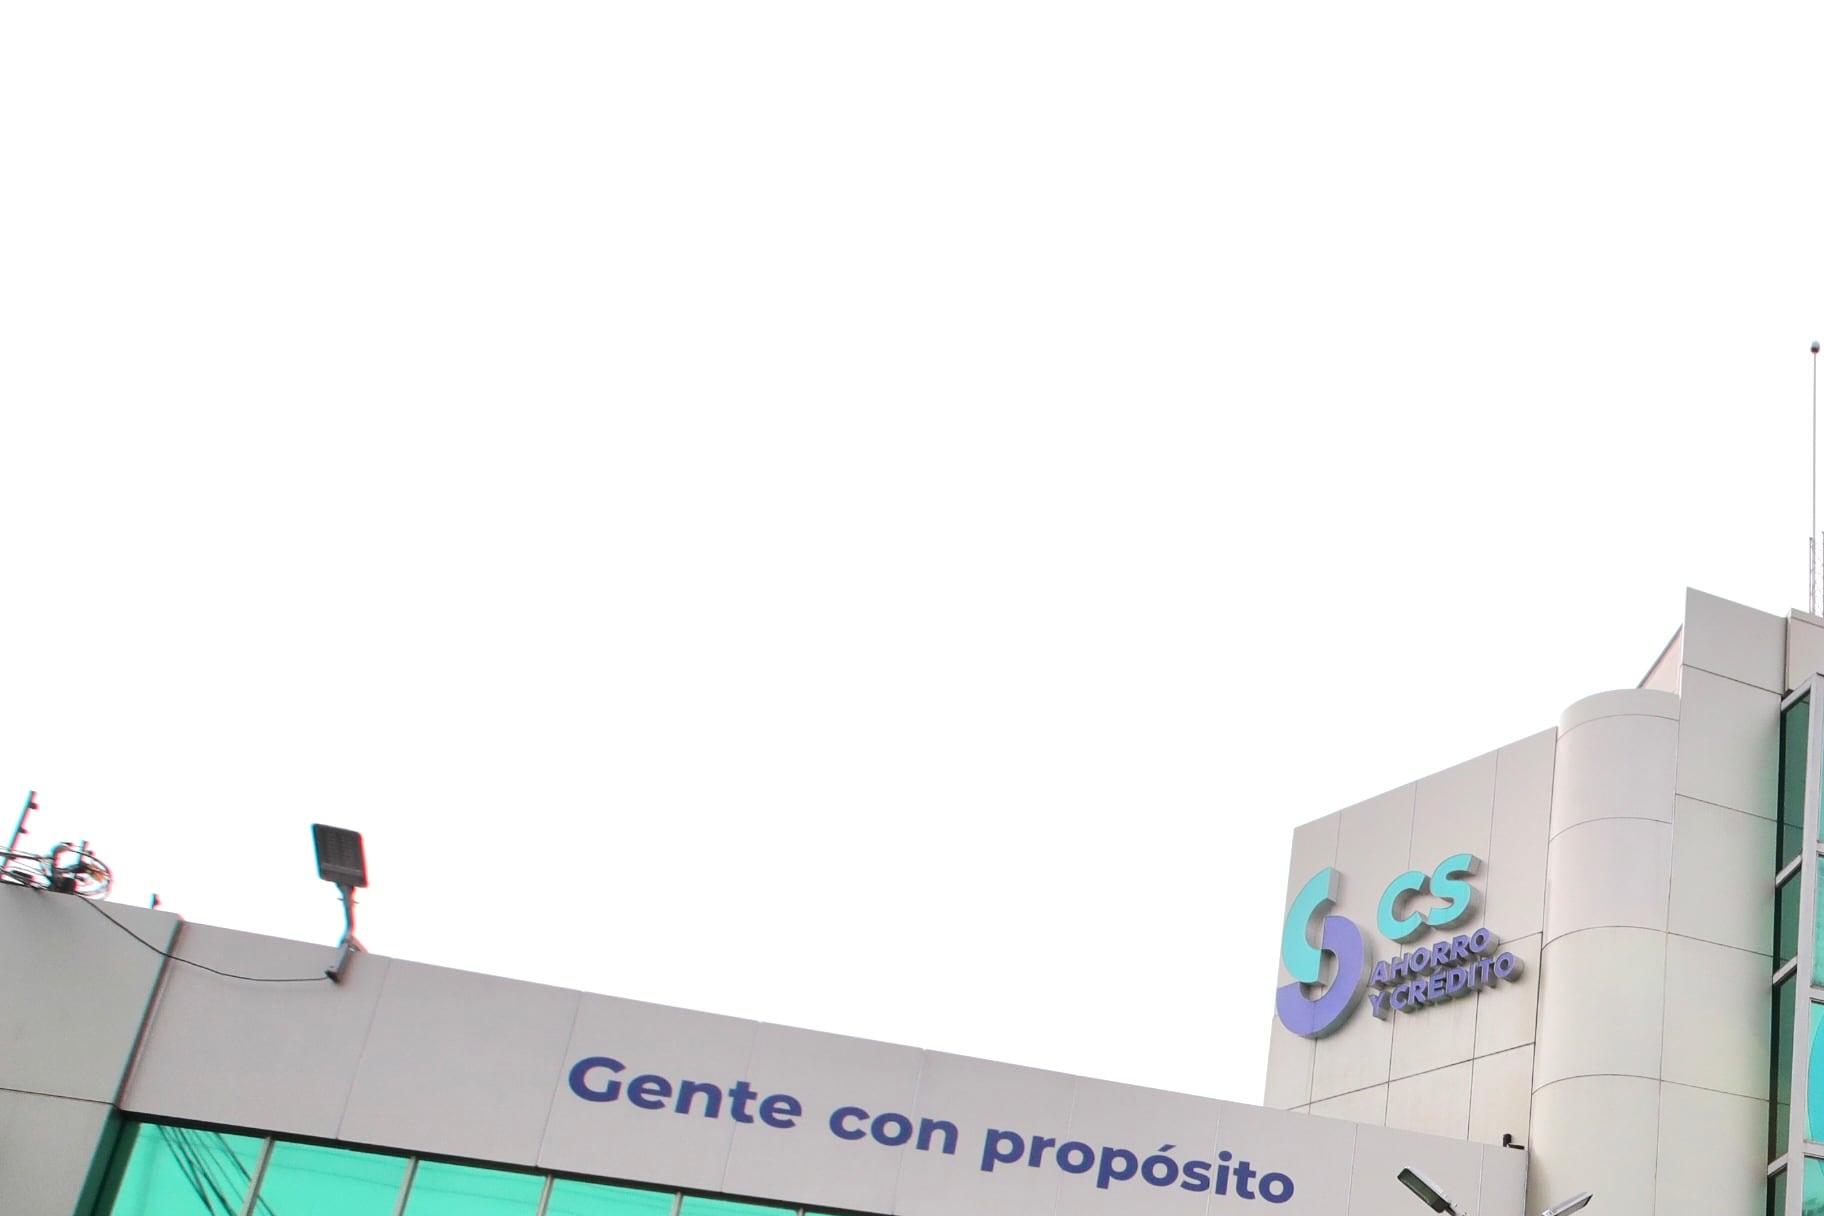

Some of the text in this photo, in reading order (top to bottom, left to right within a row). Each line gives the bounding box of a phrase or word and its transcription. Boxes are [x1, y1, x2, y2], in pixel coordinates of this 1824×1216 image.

[1376, 852, 1477, 942] CS
[1369, 928, 1495, 989] AHORRO
[1368, 991, 1389, 1019] Y
[568, 1055, 1295, 1204] Gente con propósito
